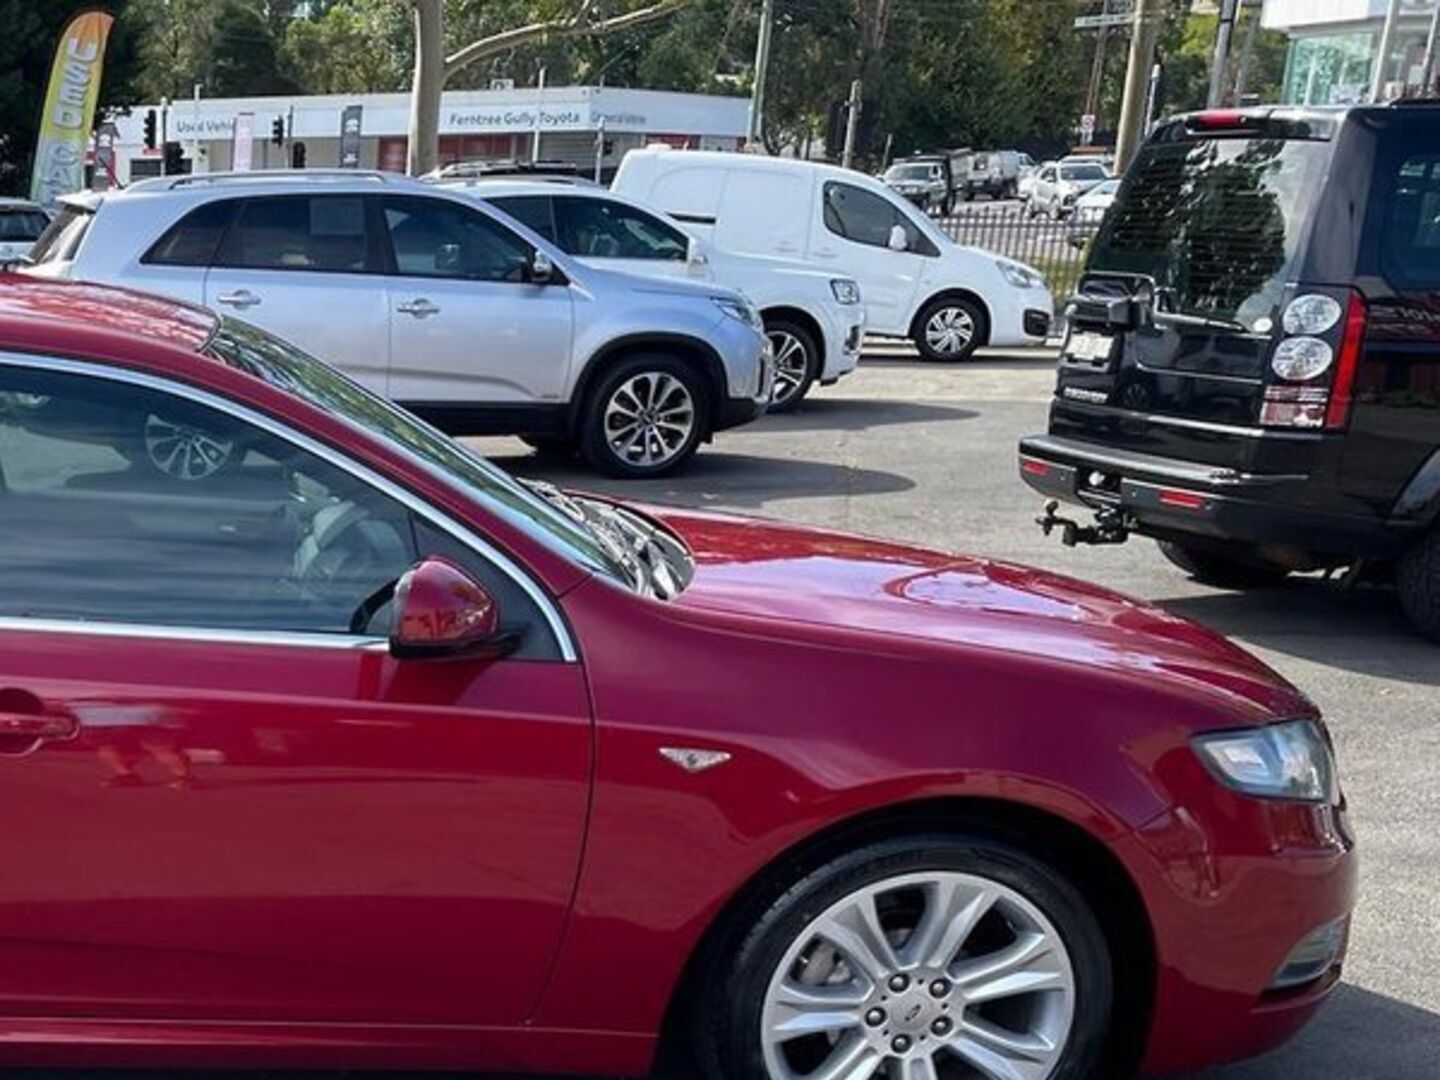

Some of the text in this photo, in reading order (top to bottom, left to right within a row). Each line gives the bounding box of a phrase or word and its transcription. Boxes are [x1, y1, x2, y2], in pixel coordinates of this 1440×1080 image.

[52, 37, 98, 129] USED
[206, 119, 233, 133] Vehi
[449, 112, 502, 126] Ferntree
[503, 112, 536, 127] Gully
[539, 110, 581, 127] Toyota
